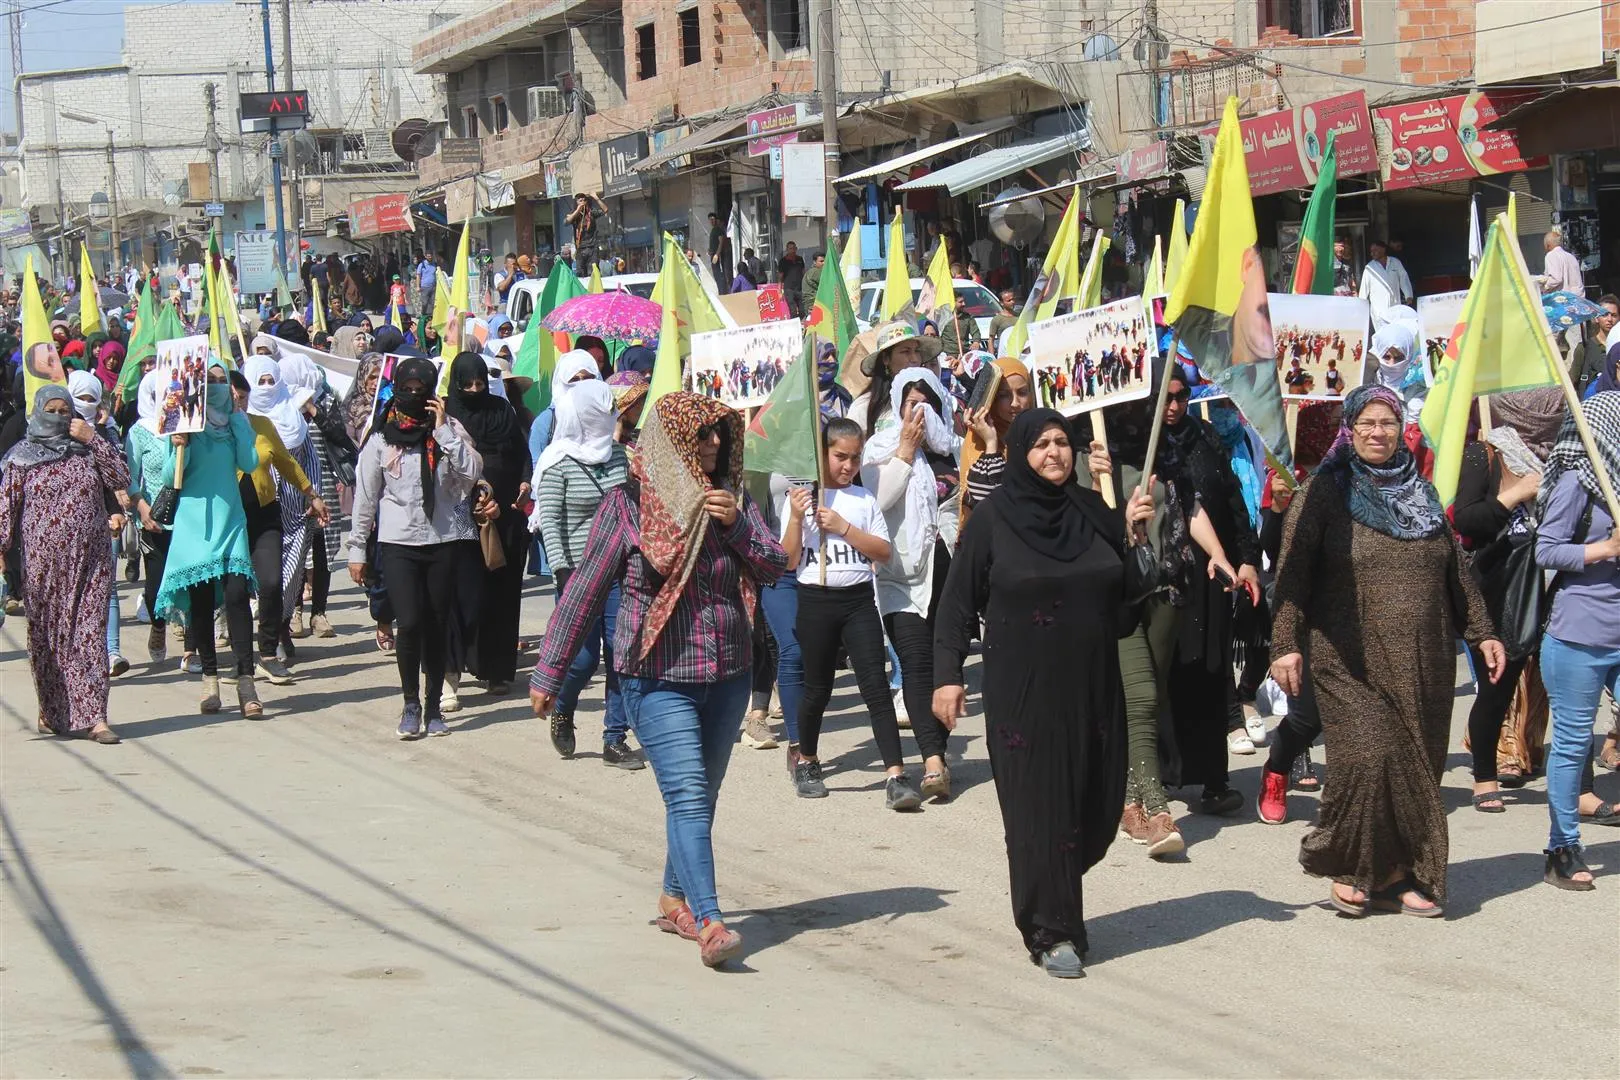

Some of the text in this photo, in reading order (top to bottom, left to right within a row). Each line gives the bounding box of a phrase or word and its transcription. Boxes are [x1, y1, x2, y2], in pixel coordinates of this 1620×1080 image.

[1333, 111, 1362, 143] الصح
[1400, 103, 1448, 126] مطعم
[1261, 119, 1292, 159] مطعم
[1400, 118, 1452, 144] الصحي
[604, 146, 626, 185] Jîn
[799, 541, 873, 568] ASHIO
